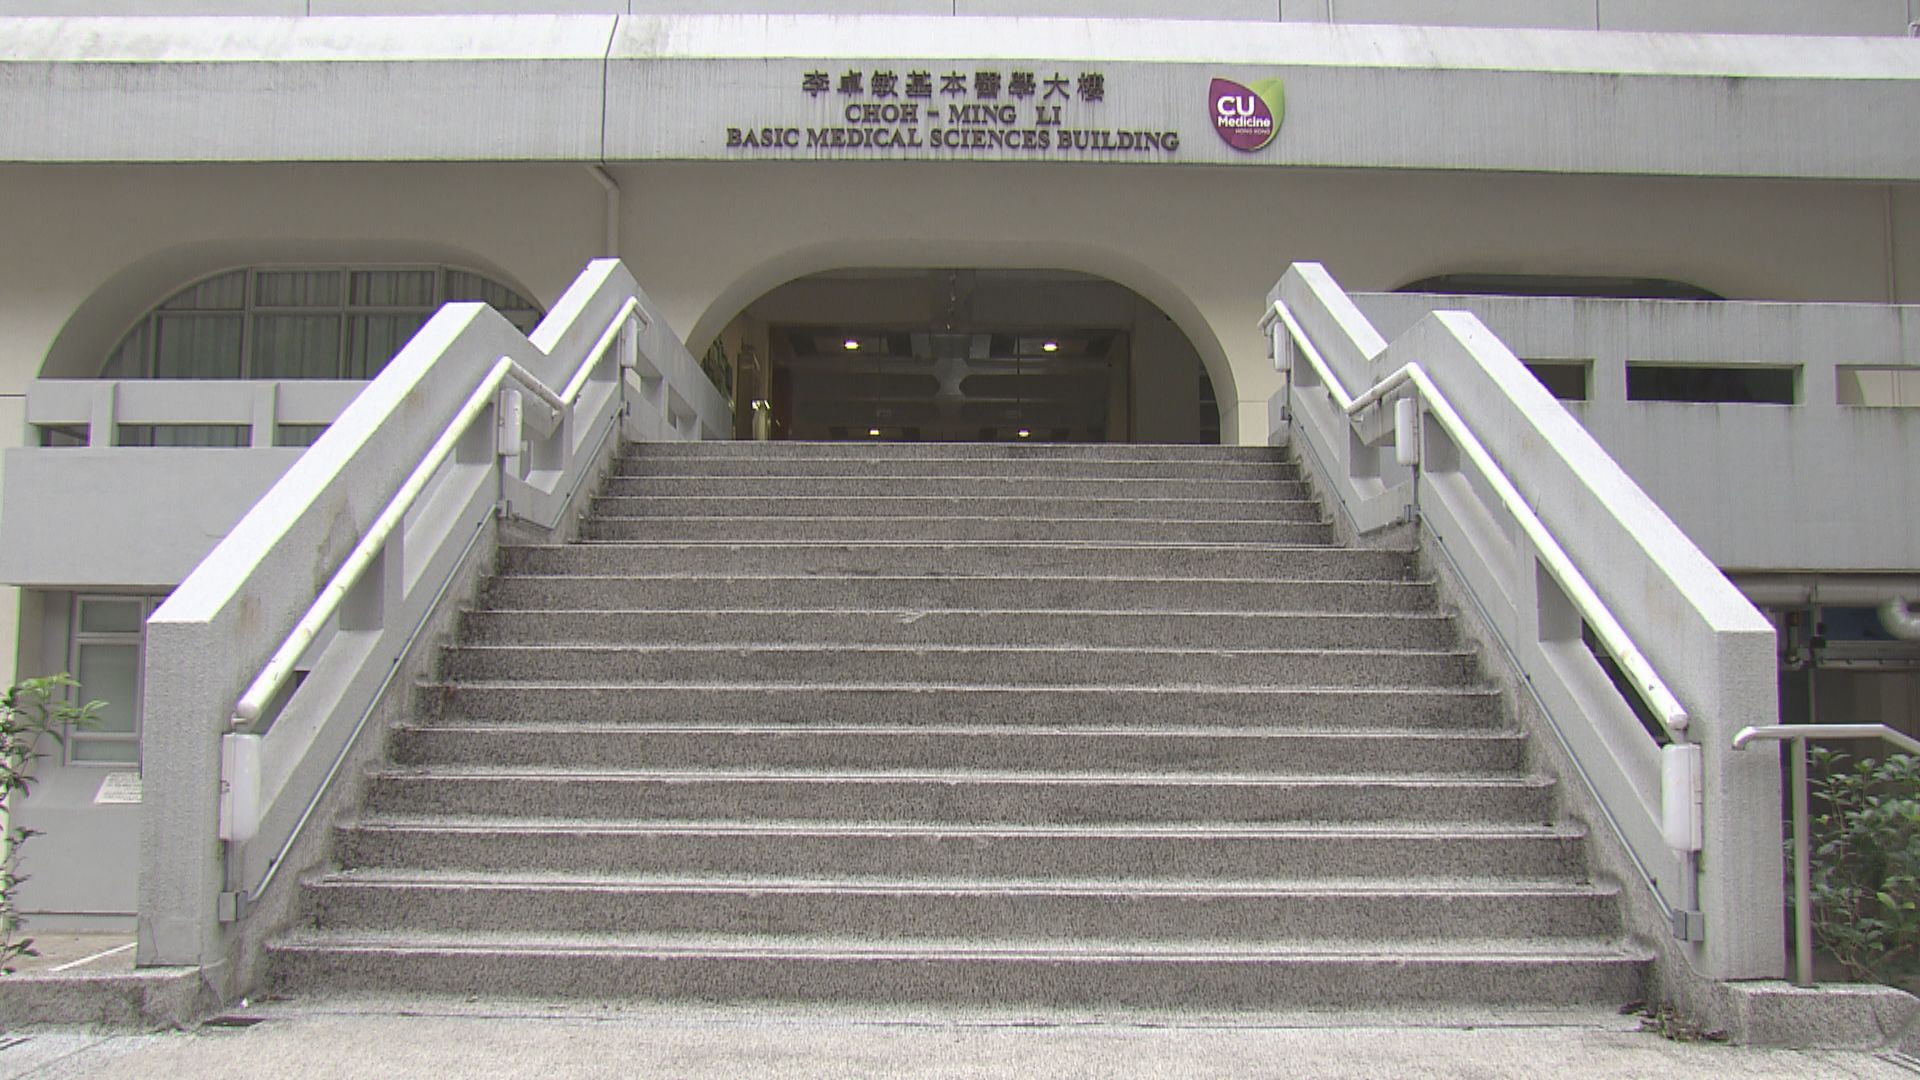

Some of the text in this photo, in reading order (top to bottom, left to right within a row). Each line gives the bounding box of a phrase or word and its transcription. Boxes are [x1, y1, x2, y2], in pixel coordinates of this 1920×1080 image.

[803, 70, 1104, 105] 李卓敏基本醫學大樓
[845, 105, 918, 124] CHOH
[949, 106, 1017, 125] MING
[1036, 107, 1061, 126] LI
[1217, 95, 1255, 116] CU
[1217, 116, 1271, 128] Medicine
[728, 128, 1180, 150] BASIC MEDICAL SCIENCES BUILDING
